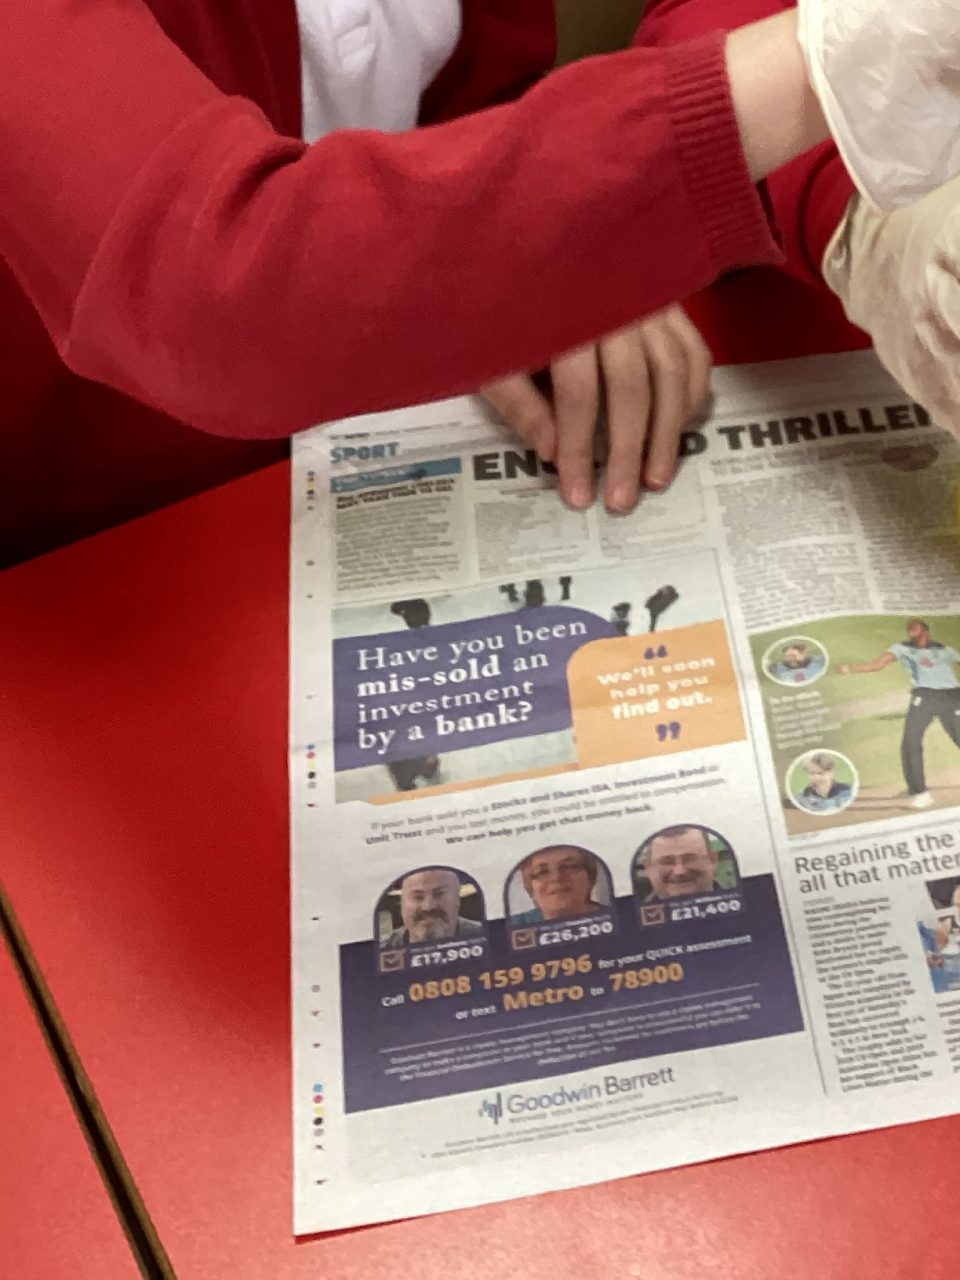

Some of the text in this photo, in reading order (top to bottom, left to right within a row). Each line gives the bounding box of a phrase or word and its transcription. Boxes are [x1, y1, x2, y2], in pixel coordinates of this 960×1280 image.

[329, 441, 400, 465] SPORT
[356, 620, 588, 671] Have you been
[356, 652, 549, 697] mis-sold an
[610, 675, 710, 700] help you
[357, 680, 535, 723] investment
[611, 691, 714, 720] find out.
[357, 700, 533, 755] by a bank?
[794, 841, 911, 874] Regaining
[915, 834, 955, 852] the
[800, 874, 826, 894] all
[834, 866, 881, 888] that
[670, 899, 742, 921] £21,400
[538, 921, 614, 947] £26,200
[381, 933, 753, 1009] Call 0808 159 9796 for your QUICK assessment
[410, 944, 483, 969] £17,900
[455, 962, 685, 1020] or text Metro to 78900
[506, 1066, 676, 1114] Goodwin Barrett
